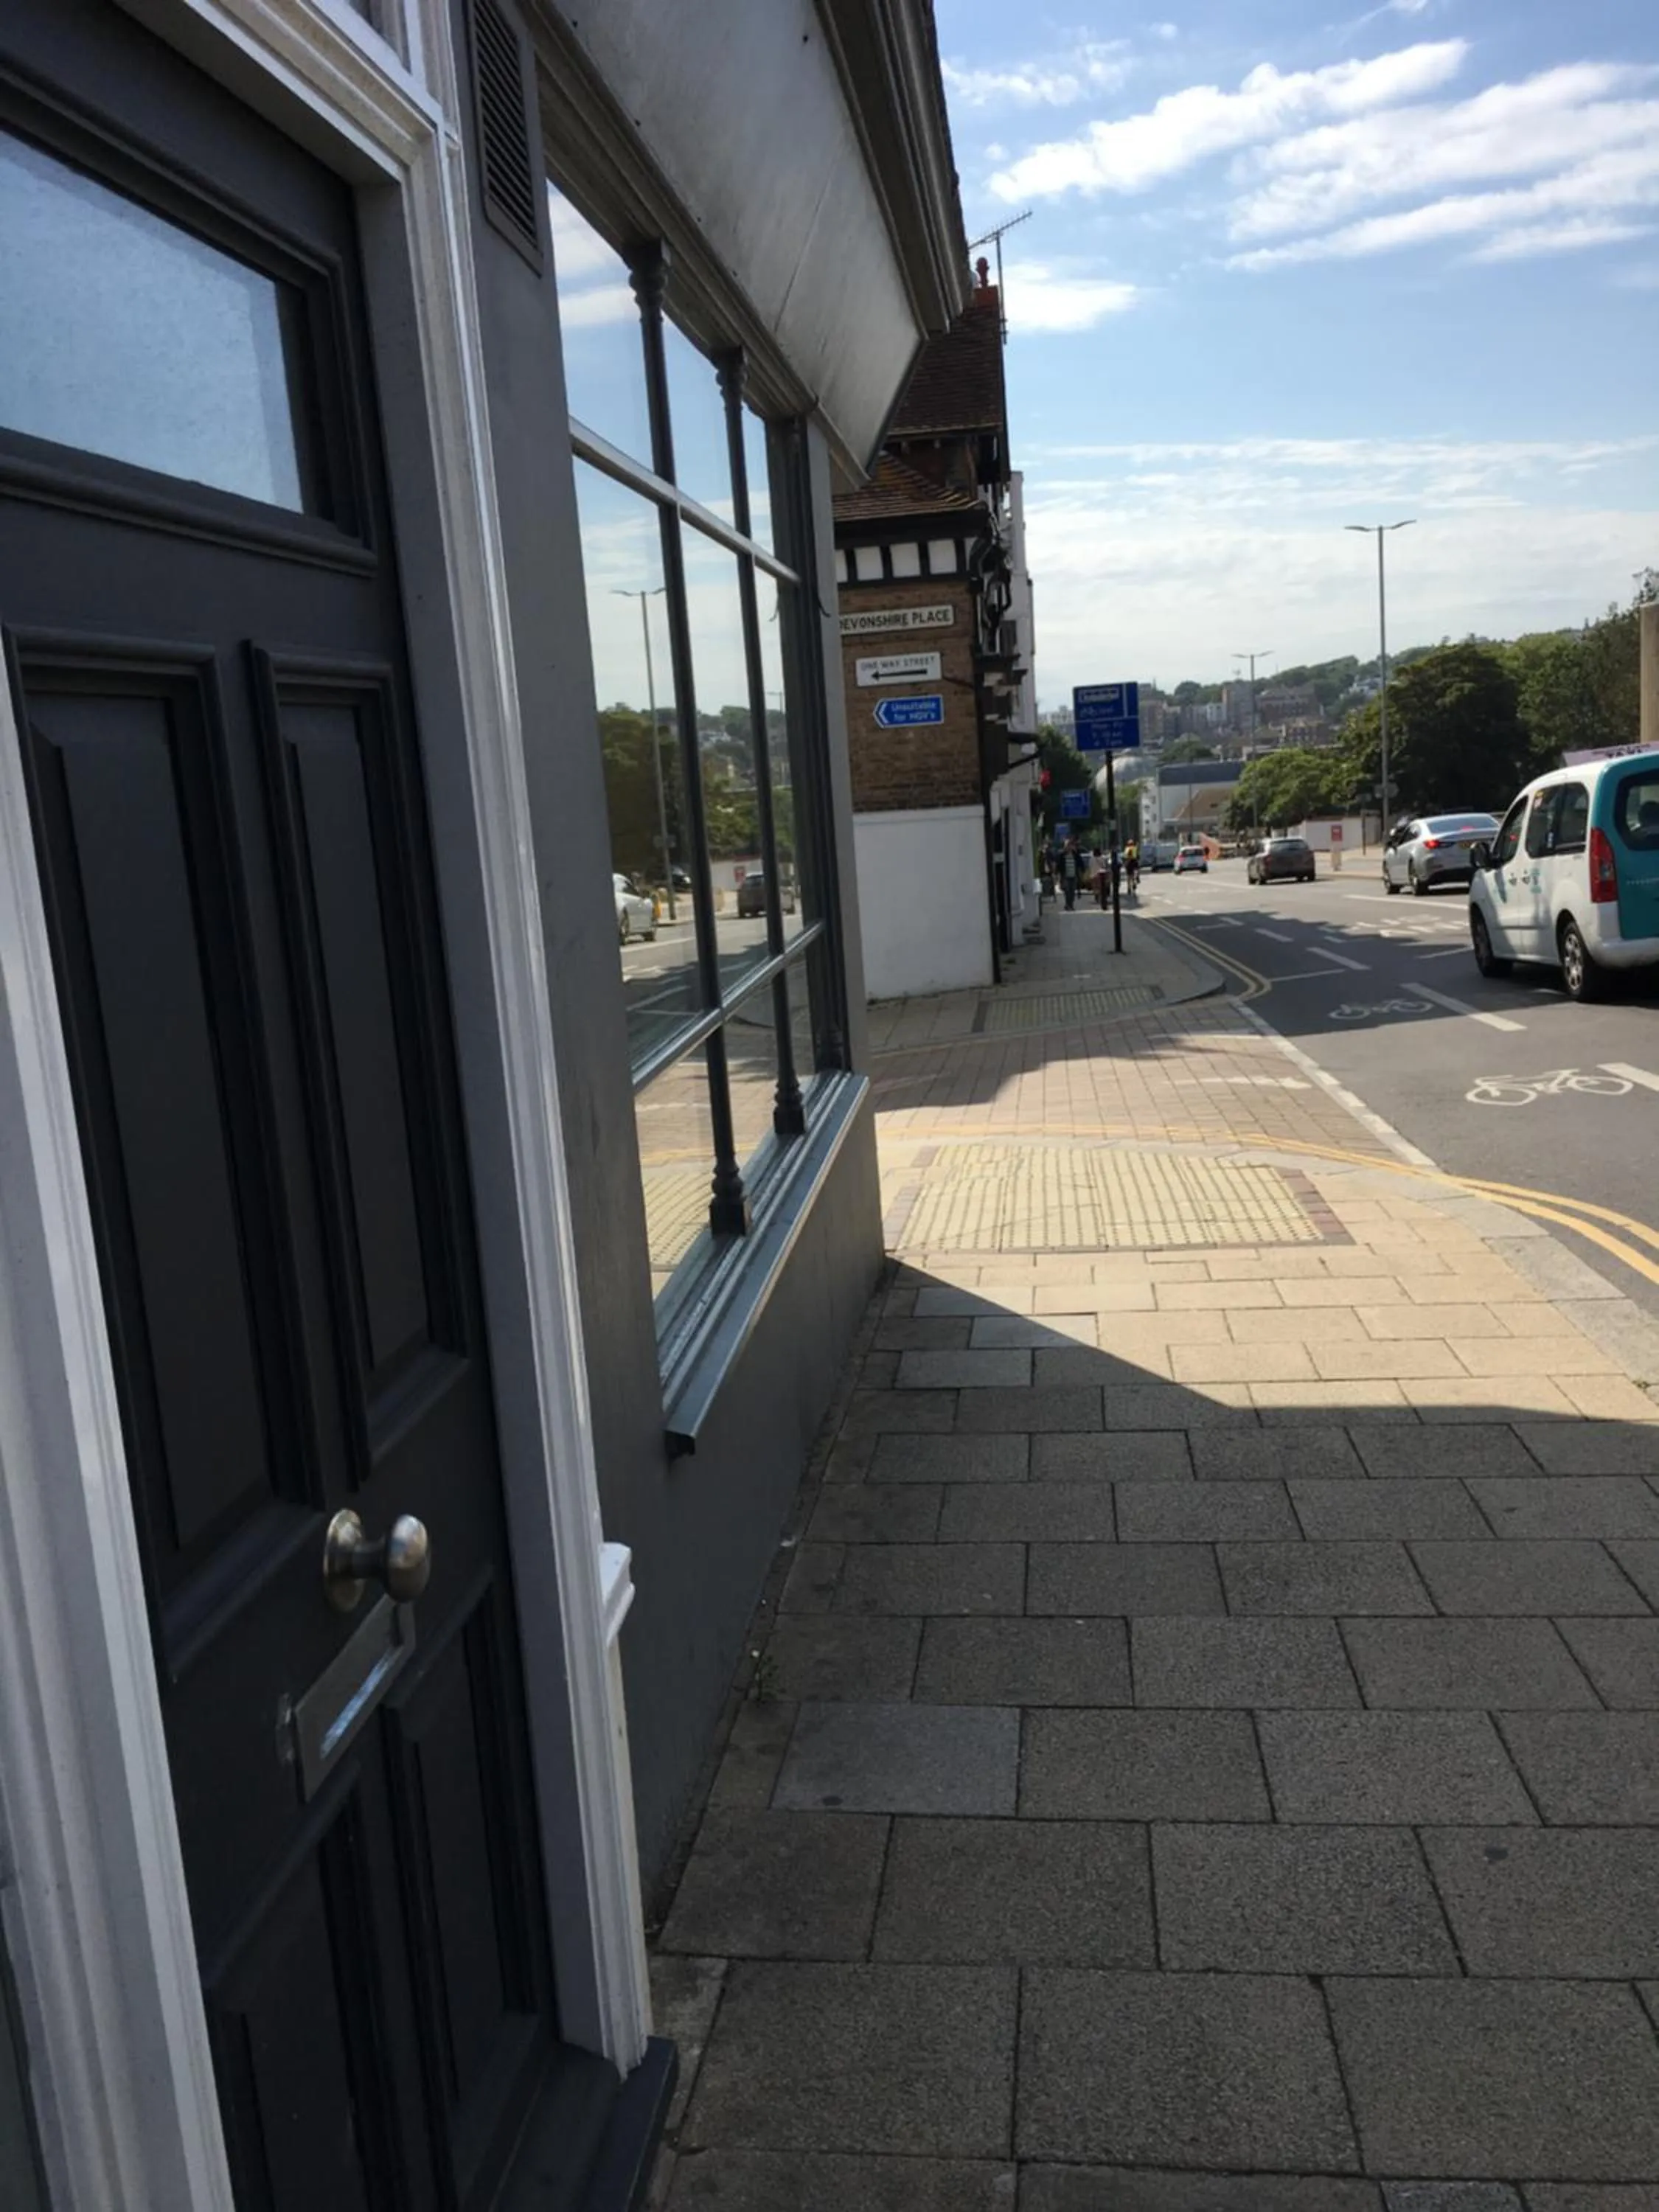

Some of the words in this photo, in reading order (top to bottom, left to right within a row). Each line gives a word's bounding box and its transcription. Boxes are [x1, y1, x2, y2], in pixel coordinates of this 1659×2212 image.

[839, 613, 908, 630] DEVONSHIRE
[912, 609, 950, 623] PLACE
[903, 655, 935, 667] STREET
